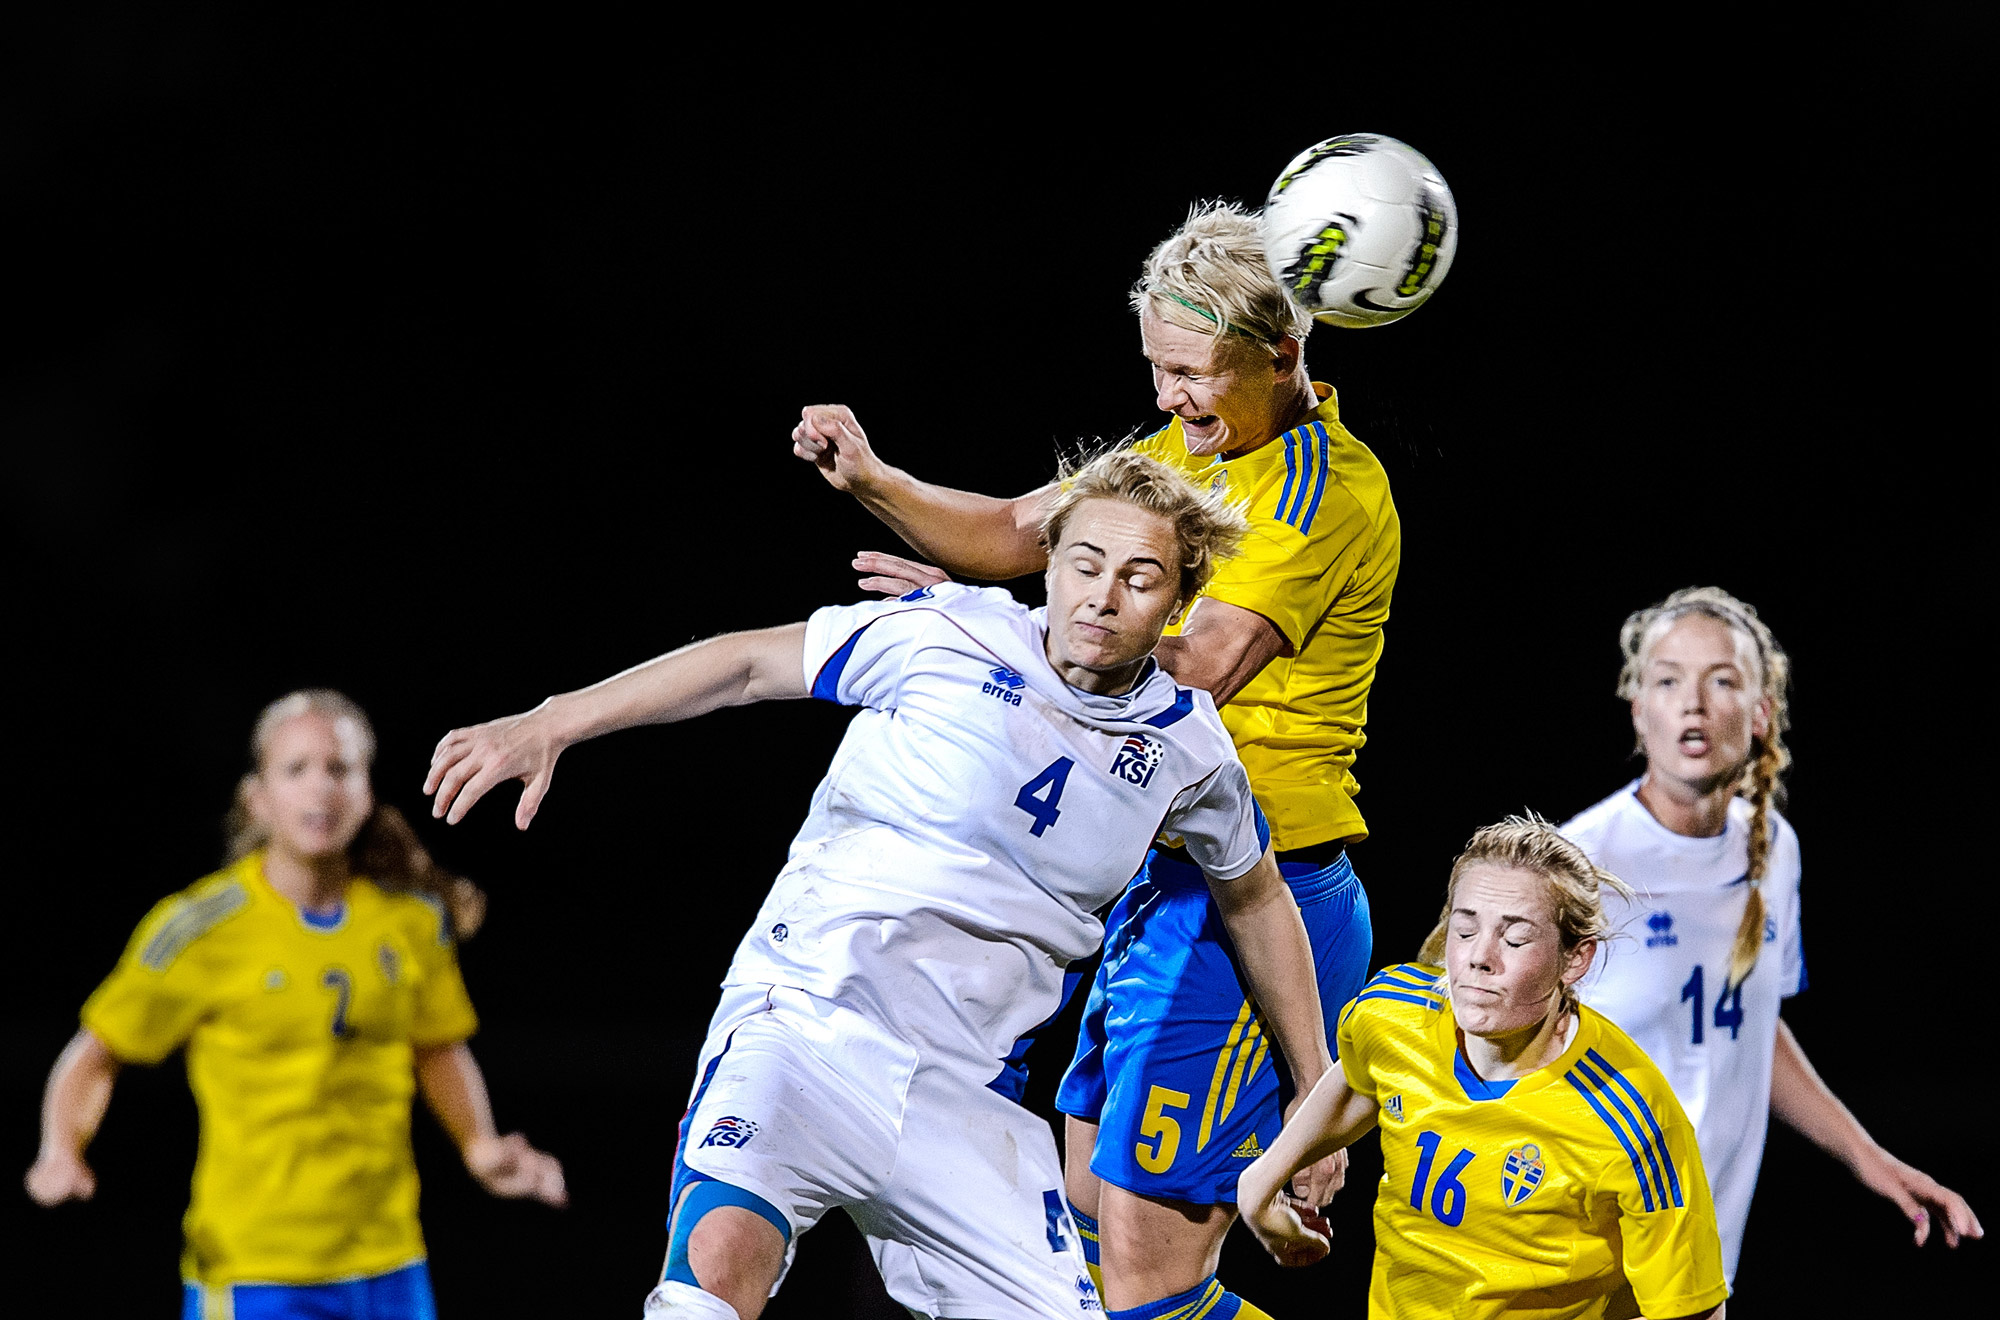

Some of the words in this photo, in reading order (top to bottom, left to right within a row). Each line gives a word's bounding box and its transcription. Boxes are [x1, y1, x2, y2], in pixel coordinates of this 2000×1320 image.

[982, 682, 1022, 707] errea
[1014, 755, 1075, 838] 4
[1680, 965, 1746, 1045] 14
[1135, 1084, 1191, 1175] 5
[1231, 1148, 1264, 1158] adidas
[1410, 1130, 1477, 1228] 16
